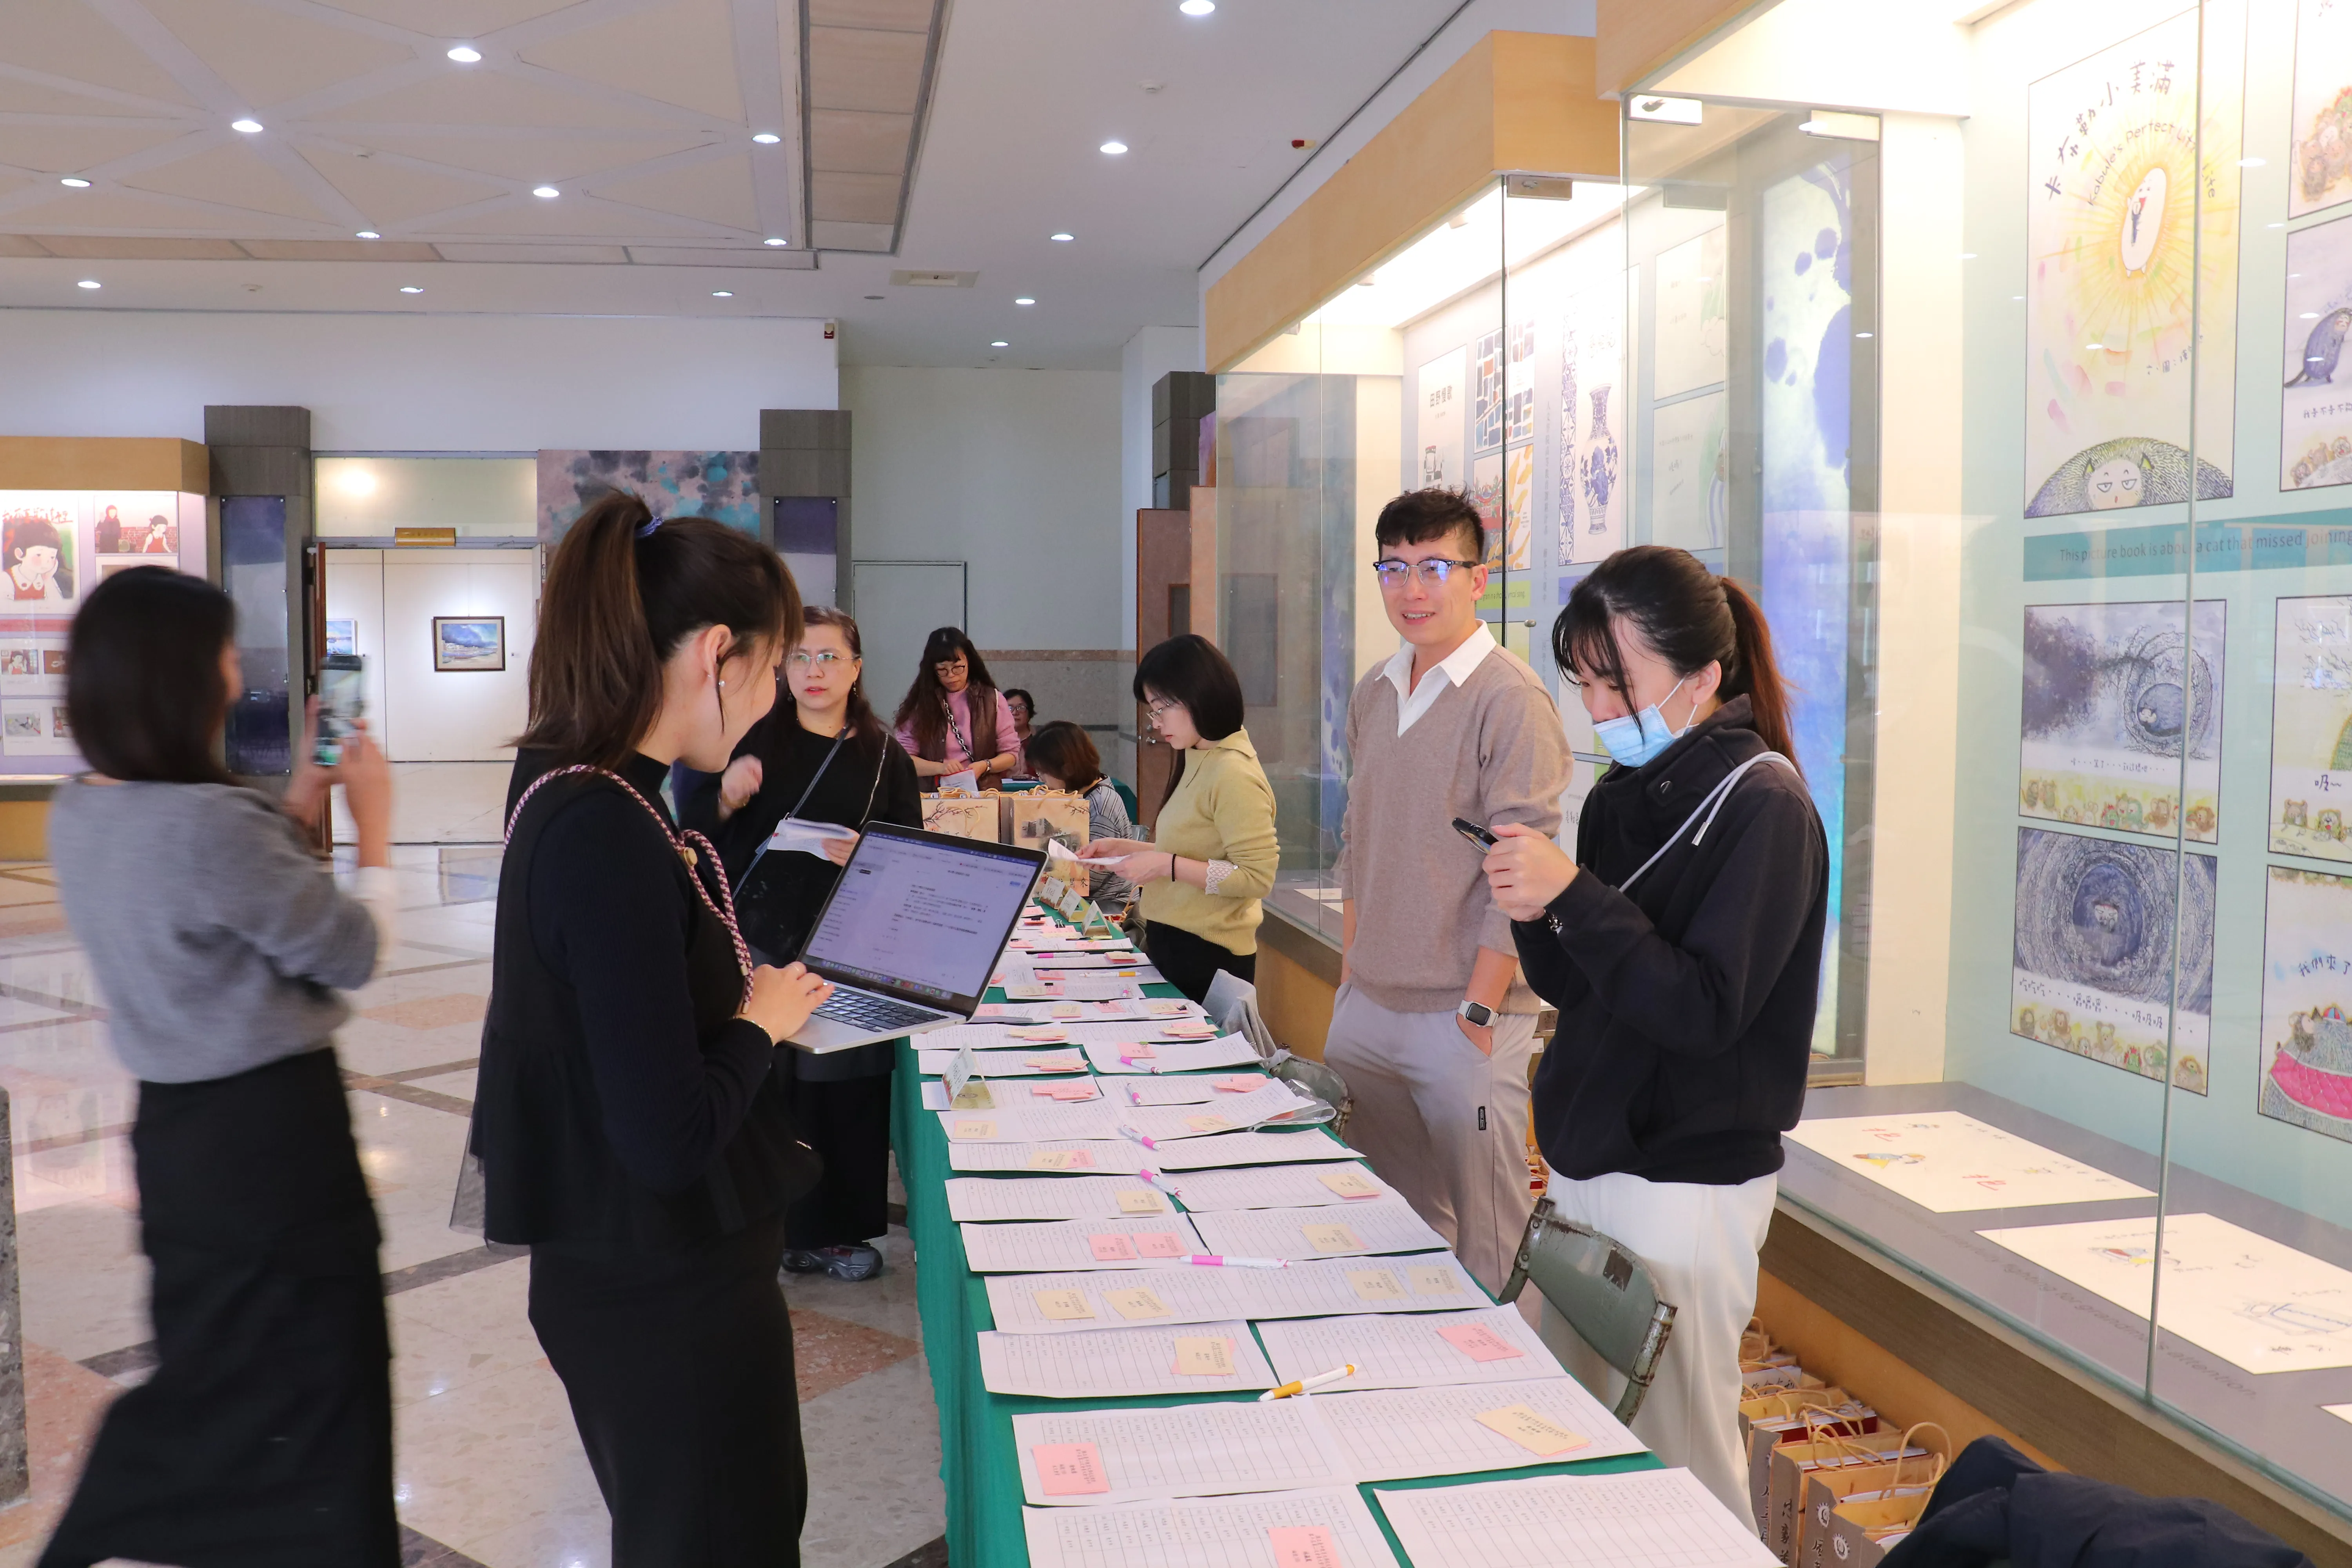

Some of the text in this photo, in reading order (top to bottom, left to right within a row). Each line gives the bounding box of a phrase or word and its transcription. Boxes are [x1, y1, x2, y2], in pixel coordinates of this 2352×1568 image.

[2125, 119, 2175, 143] perfect
[2060, 549, 2079, 562] This
[2120, 542, 2146, 557] book
[2149, 543, 2157, 556] is
[2160, 542, 2187, 555] abou
[2206, 539, 2225, 553] cat
[2227, 536, 2252, 551] that
[2256, 531, 2303, 548] missed
